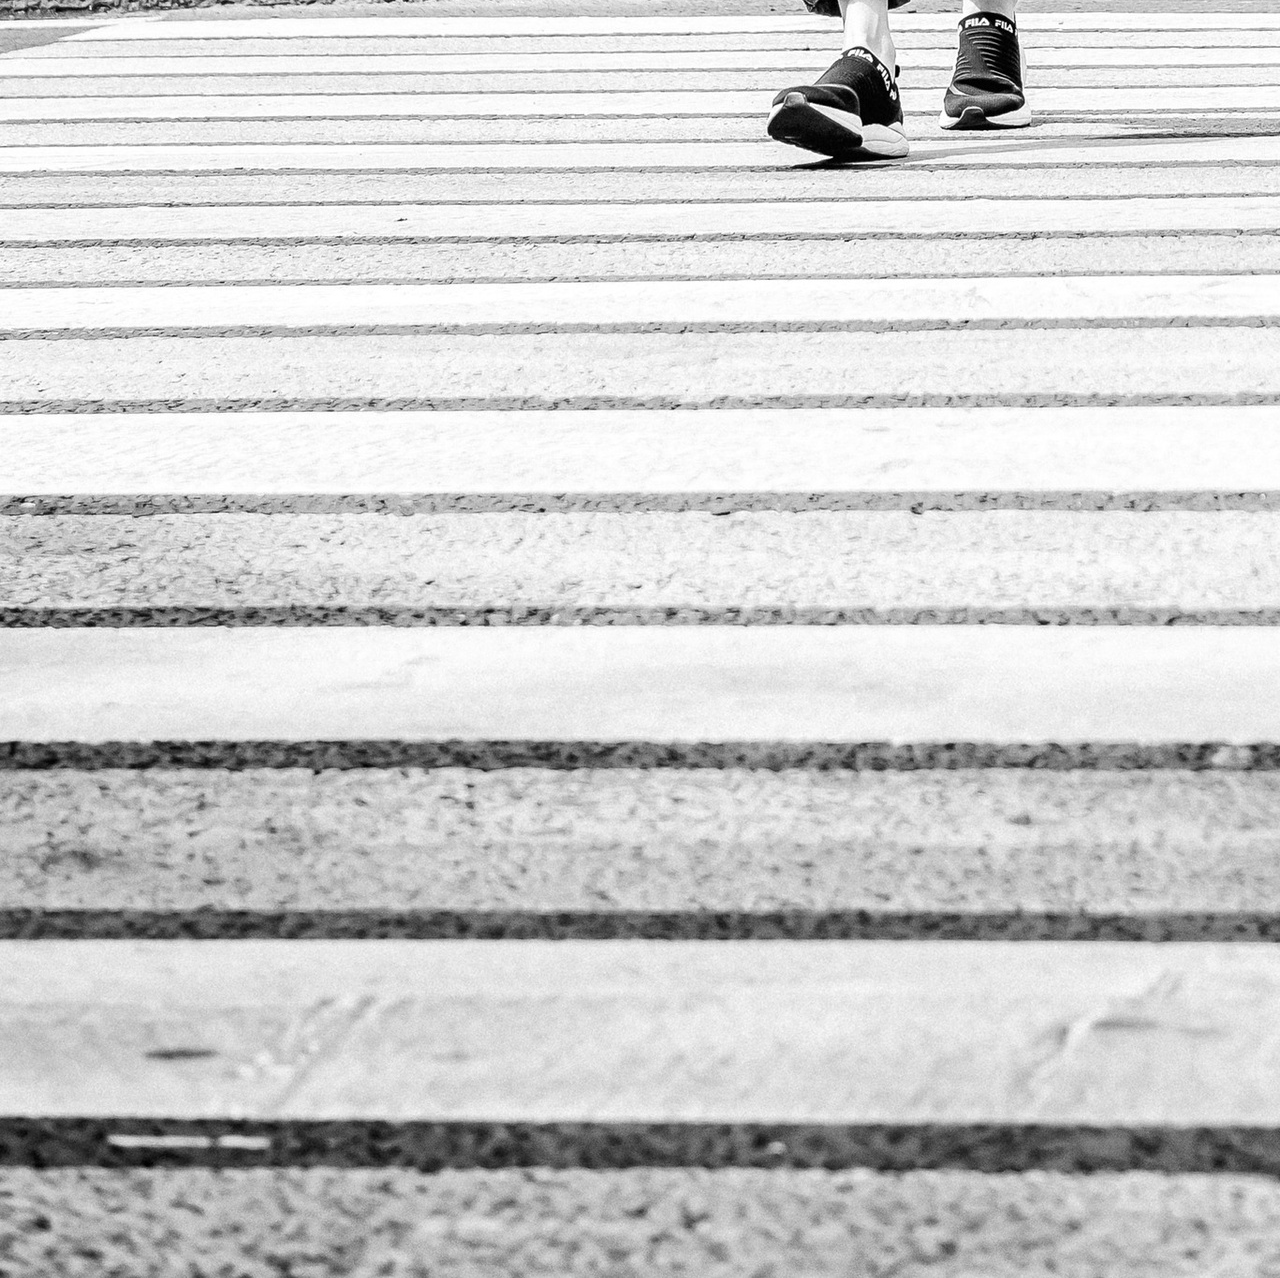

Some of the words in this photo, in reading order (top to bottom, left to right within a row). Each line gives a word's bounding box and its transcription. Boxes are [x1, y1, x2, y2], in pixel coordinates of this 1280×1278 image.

[964, 17, 990, 29] FILA
[994, 19, 1013, 34] FILA
[847, 48, 874, 63] FILA
[876, 62, 891, 92] FILA
